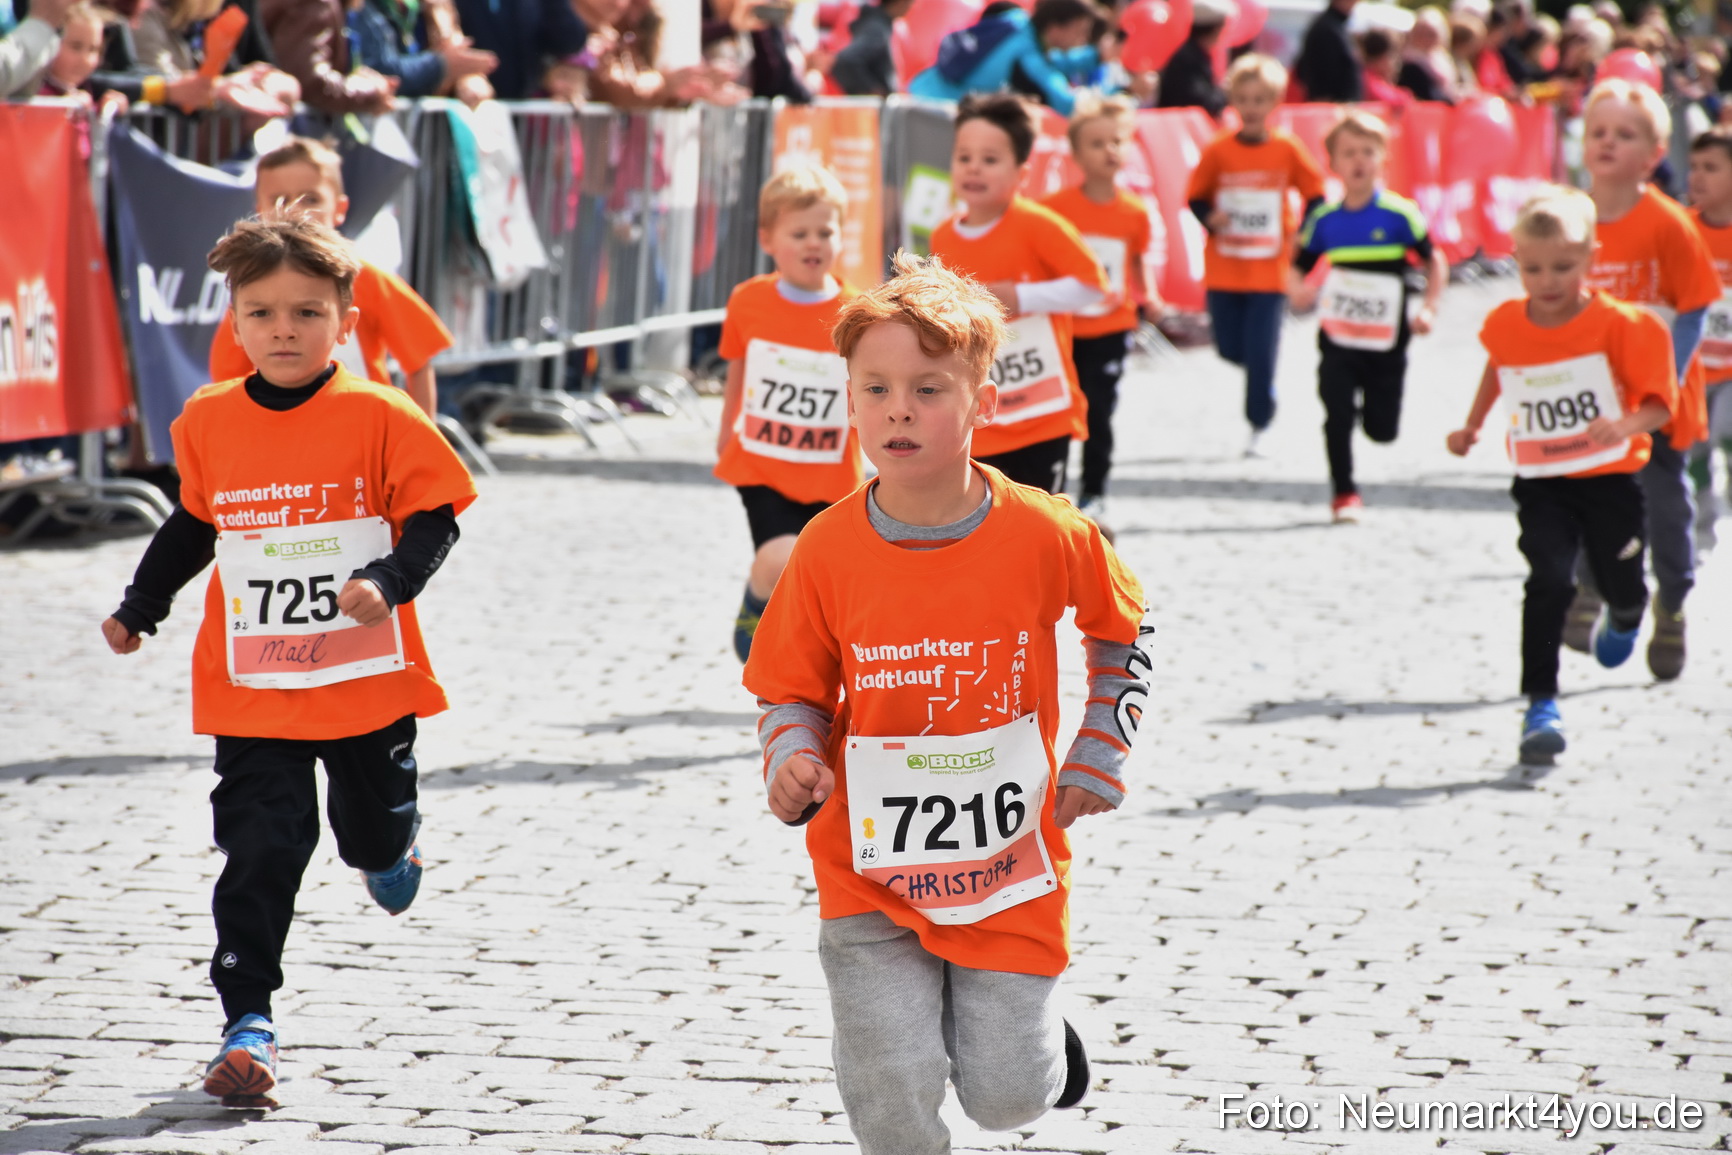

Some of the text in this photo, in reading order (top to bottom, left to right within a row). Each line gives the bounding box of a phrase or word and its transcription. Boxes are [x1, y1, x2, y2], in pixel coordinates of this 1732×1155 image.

[989, 349, 1043, 388] 055
[761, 378, 839, 420] 7257
[1520, 390, 1600, 434] 7098
[756, 420, 839, 452] ADAM
[215, 506, 291, 528] tadtlauf
[280, 536, 341, 557] BOCK
[247, 573, 340, 625] 725
[258, 633, 327, 665] Maël
[855, 664, 947, 692] tadtlauf
[928, 746, 995, 770] BOCK
[881, 781, 1027, 853] 7216
[861, 847, 876, 860] B2
[886, 853, 1018, 900] CHRISTOPH
